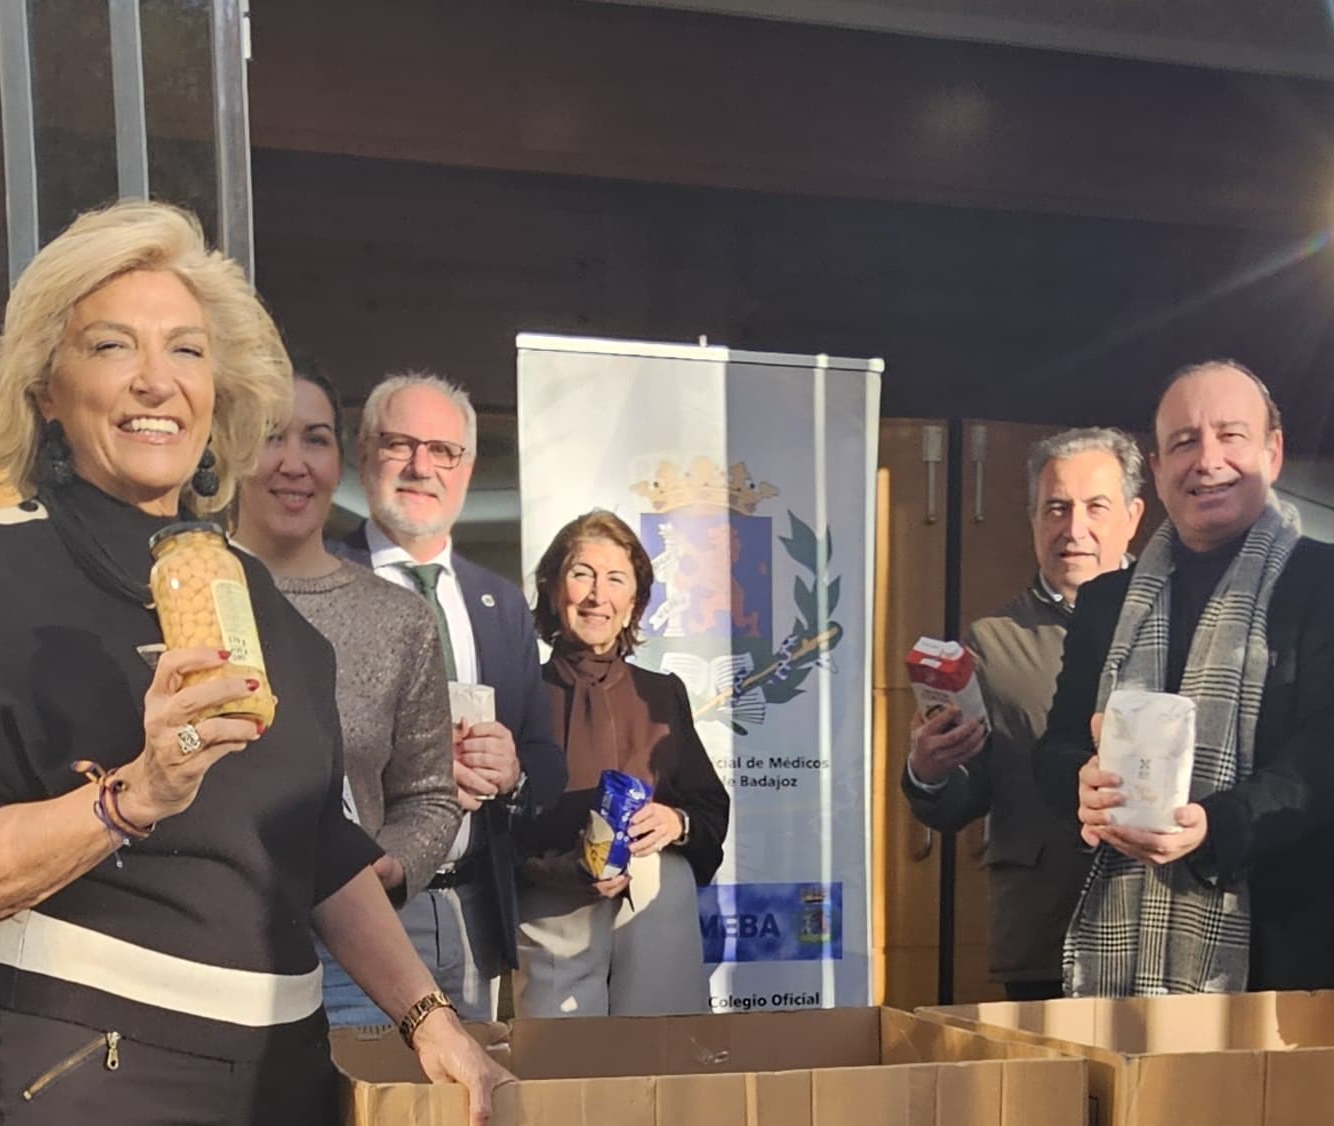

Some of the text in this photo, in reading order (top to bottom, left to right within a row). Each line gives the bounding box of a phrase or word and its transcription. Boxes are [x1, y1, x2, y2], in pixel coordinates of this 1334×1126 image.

[746, 757, 764, 769] de
[769, 757, 830, 769] Médicos
[740, 776, 798, 790] Badajoz
[708, 992, 820, 1010] Colegio Oficial
